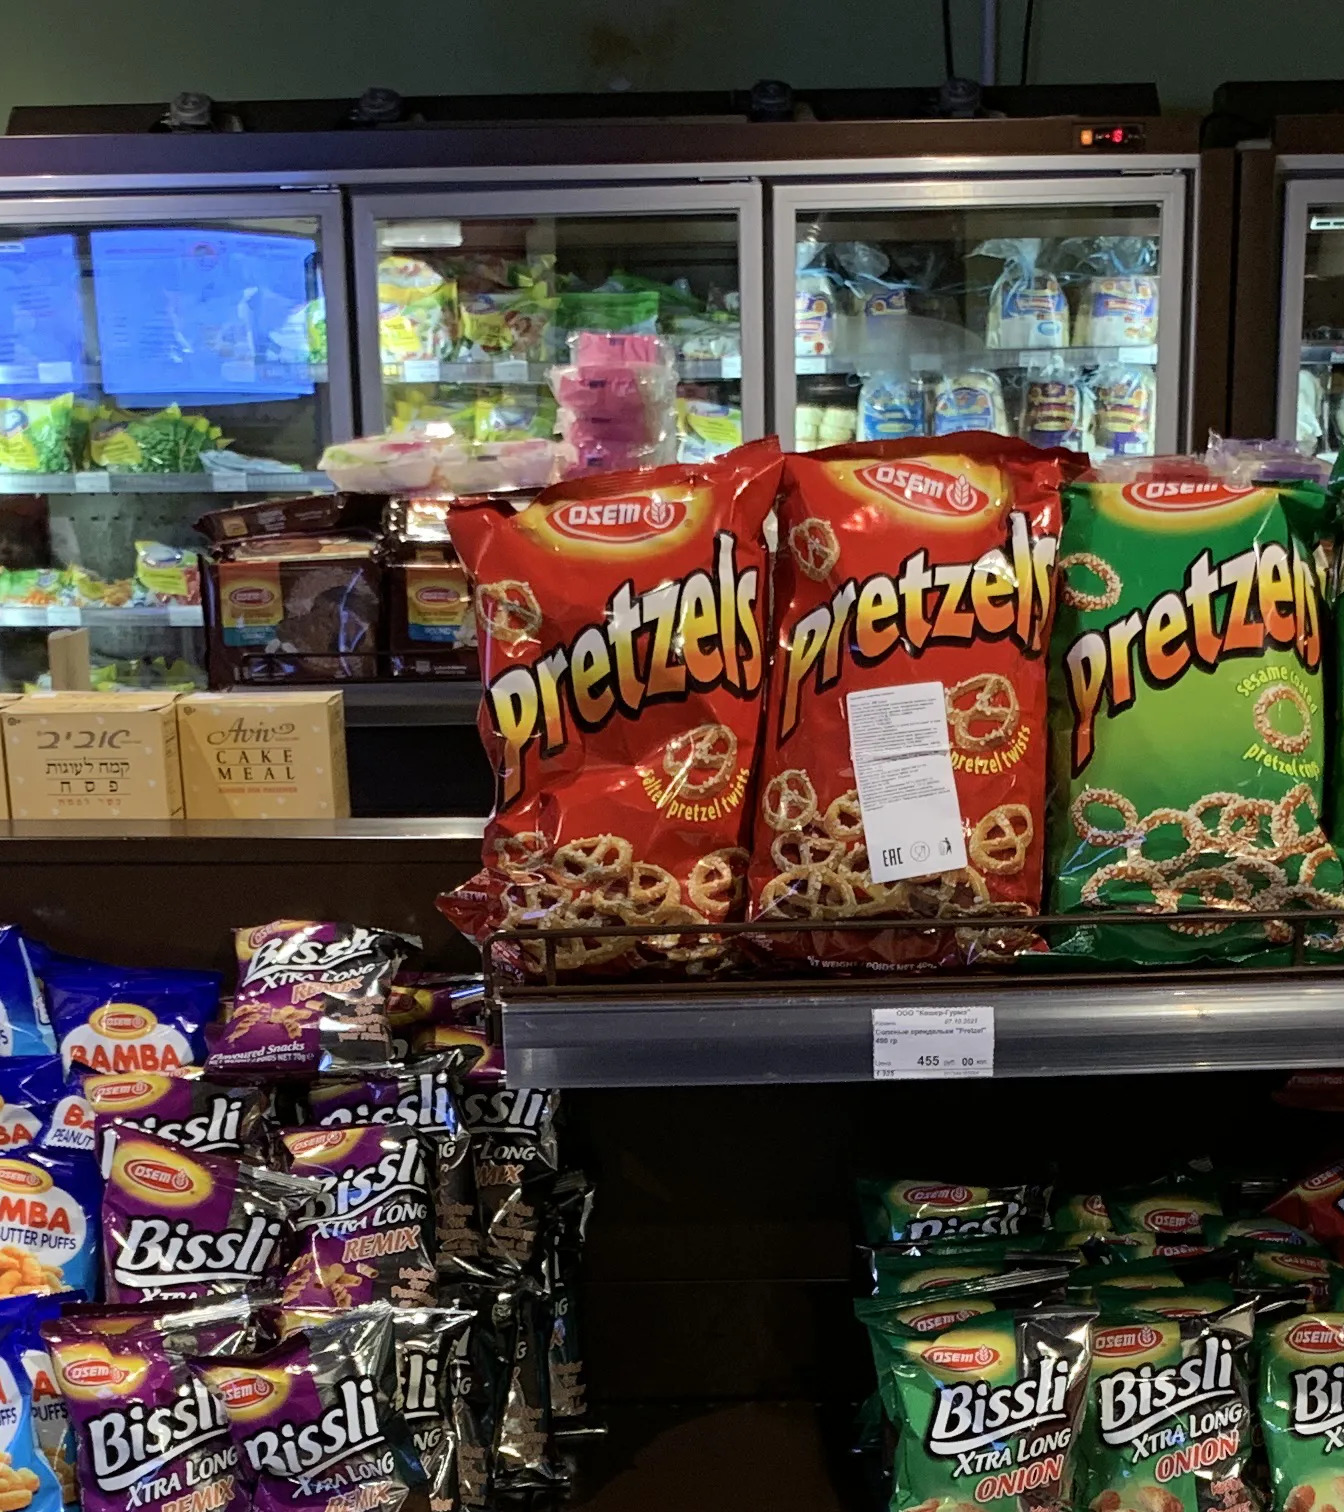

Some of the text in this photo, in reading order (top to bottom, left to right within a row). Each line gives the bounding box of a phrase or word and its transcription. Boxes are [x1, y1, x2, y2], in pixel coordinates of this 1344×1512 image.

[568, 503, 641, 525] OSEM
[1236, 665, 1289, 697] sesame
[207, 718, 295, 745] Aviv
[1000, 723, 1032, 768] twists
[217, 749, 293, 764] CAKE
[218, 767, 296, 780] MEAL
[666, 766, 751, 824] pretzel twists
[917, 1055, 974, 1066] 455 00
[117, 1217, 280, 1287] Bissli
[932, 1349, 972, 1365] OSEM
[934, 1359, 1070, 1442] Bissli
[1100, 1338, 1233, 1432] Bissli
[182, 1446, 238, 1486] LONG
[954, 1428, 1072, 1478] XTRA LONG
[1156, 1430, 1239, 1482] ONION
[974, 1455, 1064, 1502] ONION
